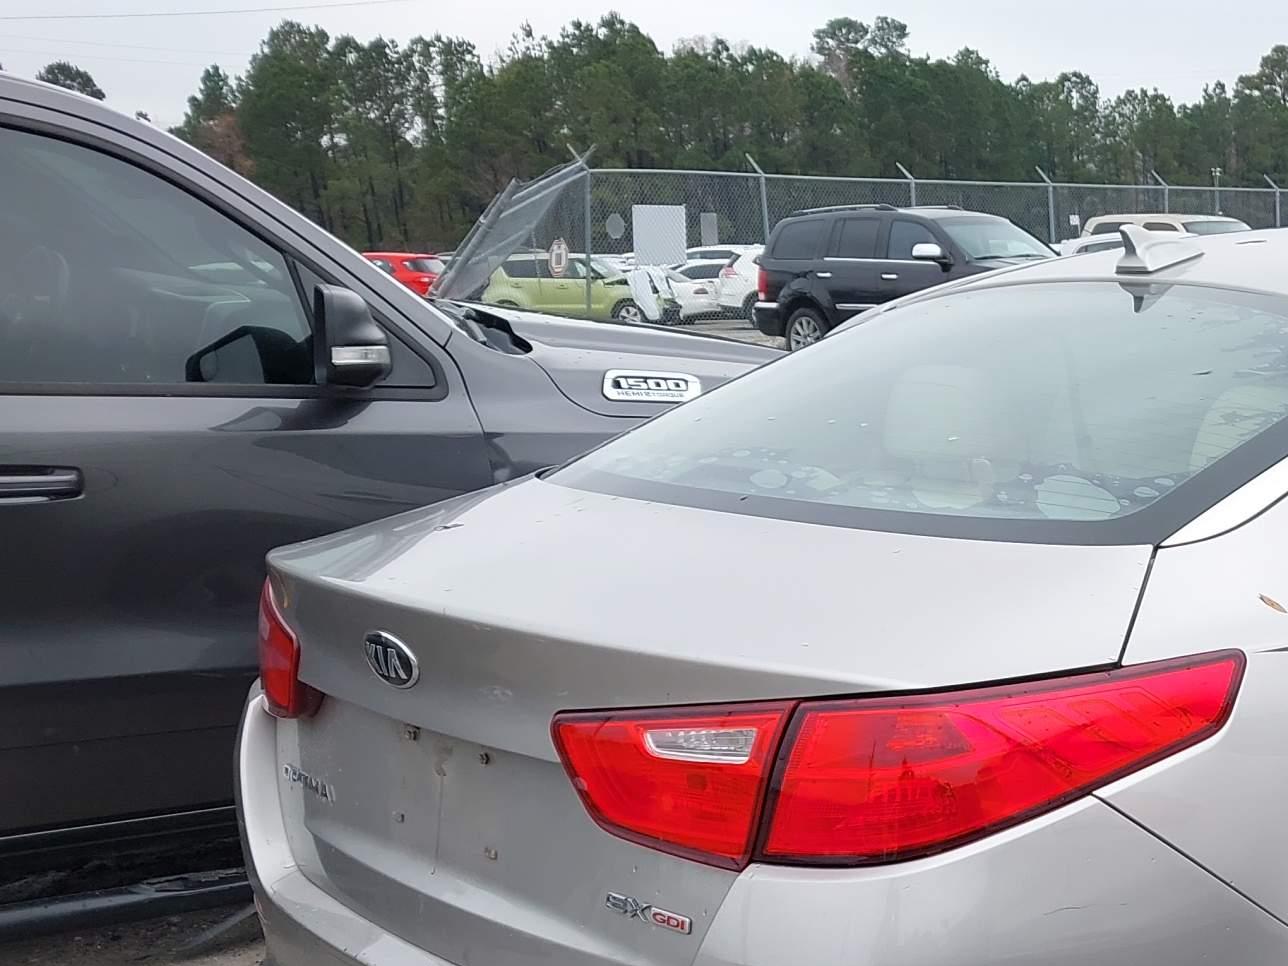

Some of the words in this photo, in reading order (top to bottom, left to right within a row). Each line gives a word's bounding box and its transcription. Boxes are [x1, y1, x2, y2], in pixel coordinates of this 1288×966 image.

[612, 376, 689, 391] 1500
[364, 638, 410, 681] KIA
[652, 911, 686, 931] GDI
